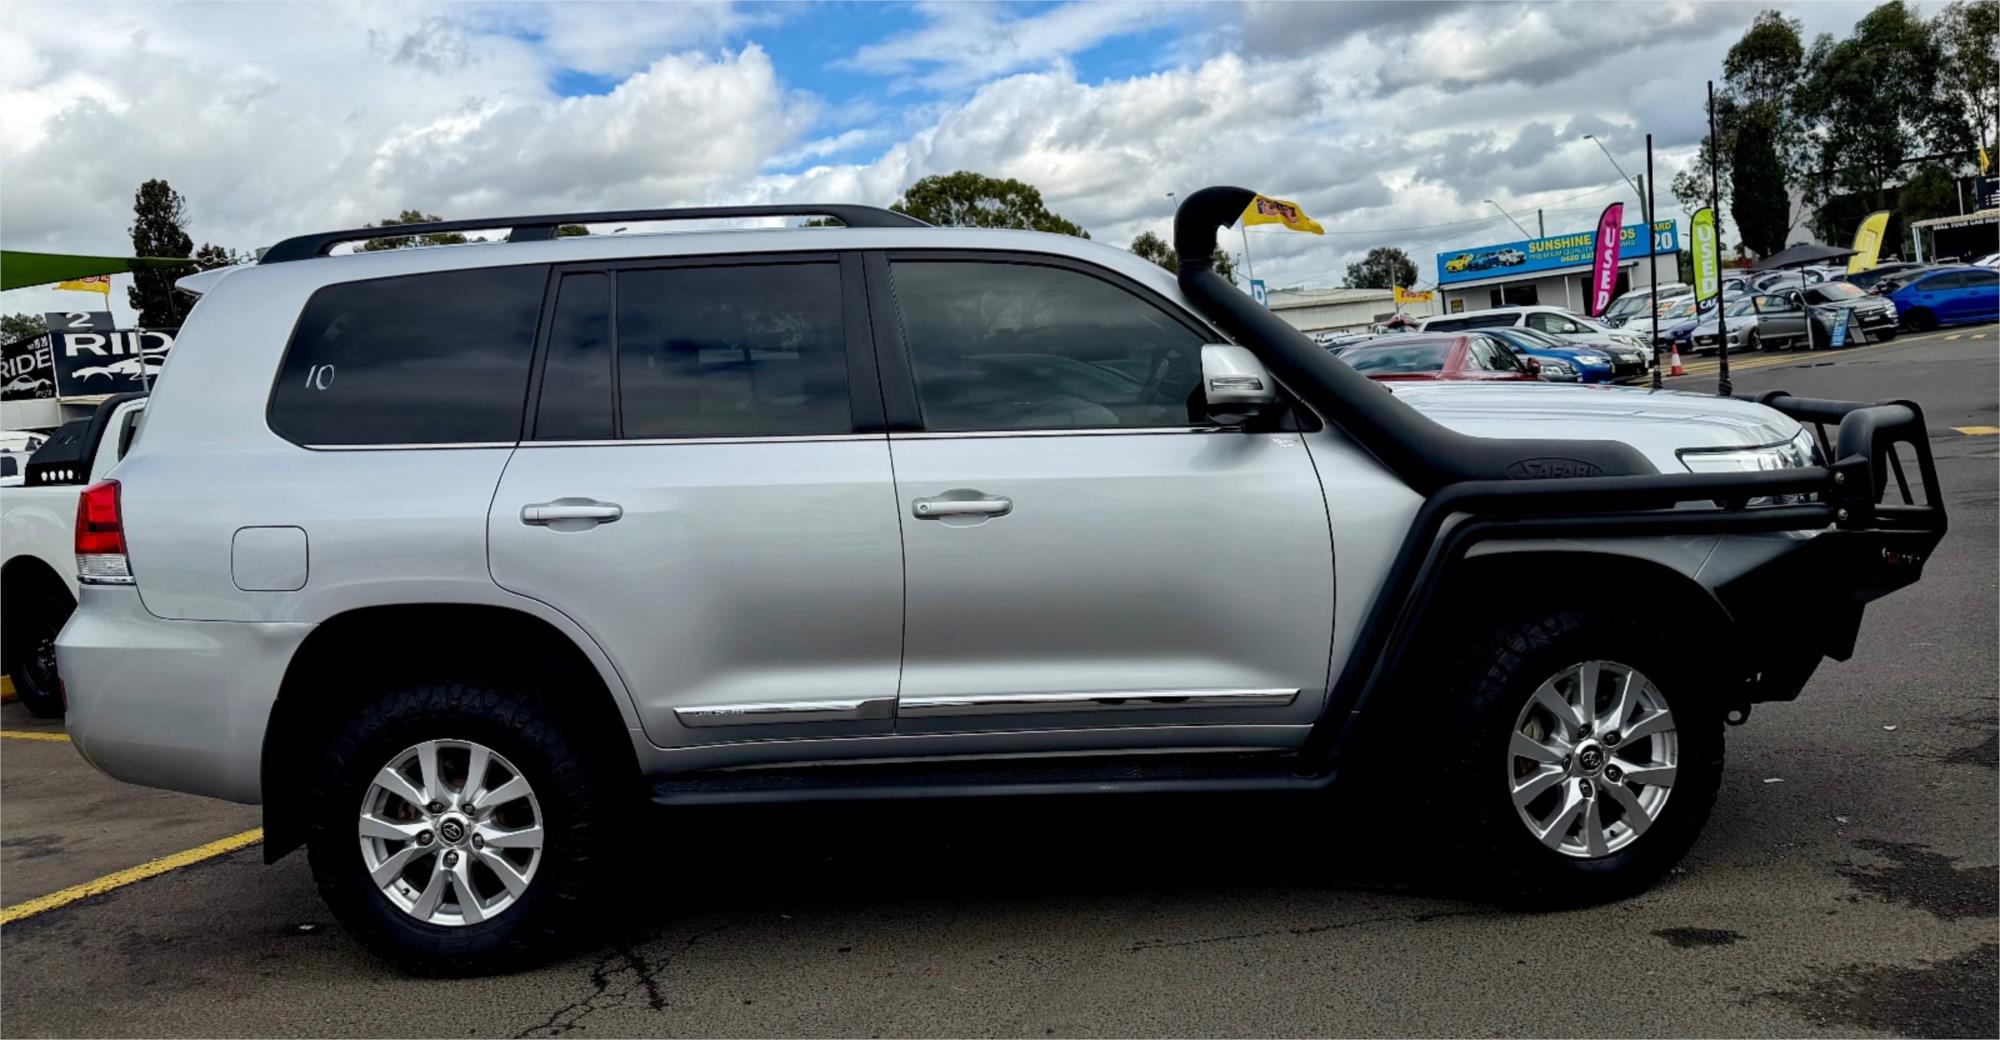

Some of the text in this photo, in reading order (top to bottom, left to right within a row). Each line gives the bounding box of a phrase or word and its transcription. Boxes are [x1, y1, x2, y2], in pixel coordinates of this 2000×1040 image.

[1528, 234, 1592, 253] SUNSHINE
[1596, 227, 1616, 311] USED
[1698, 225, 1718, 295] USED
[65, 311, 94, 328] 2
[63, 331, 175, 357] RID
[1, 347, 52, 378] RIDE
[305, 364, 335, 390] 10
[1519, 461, 1594, 480] SAFARI
